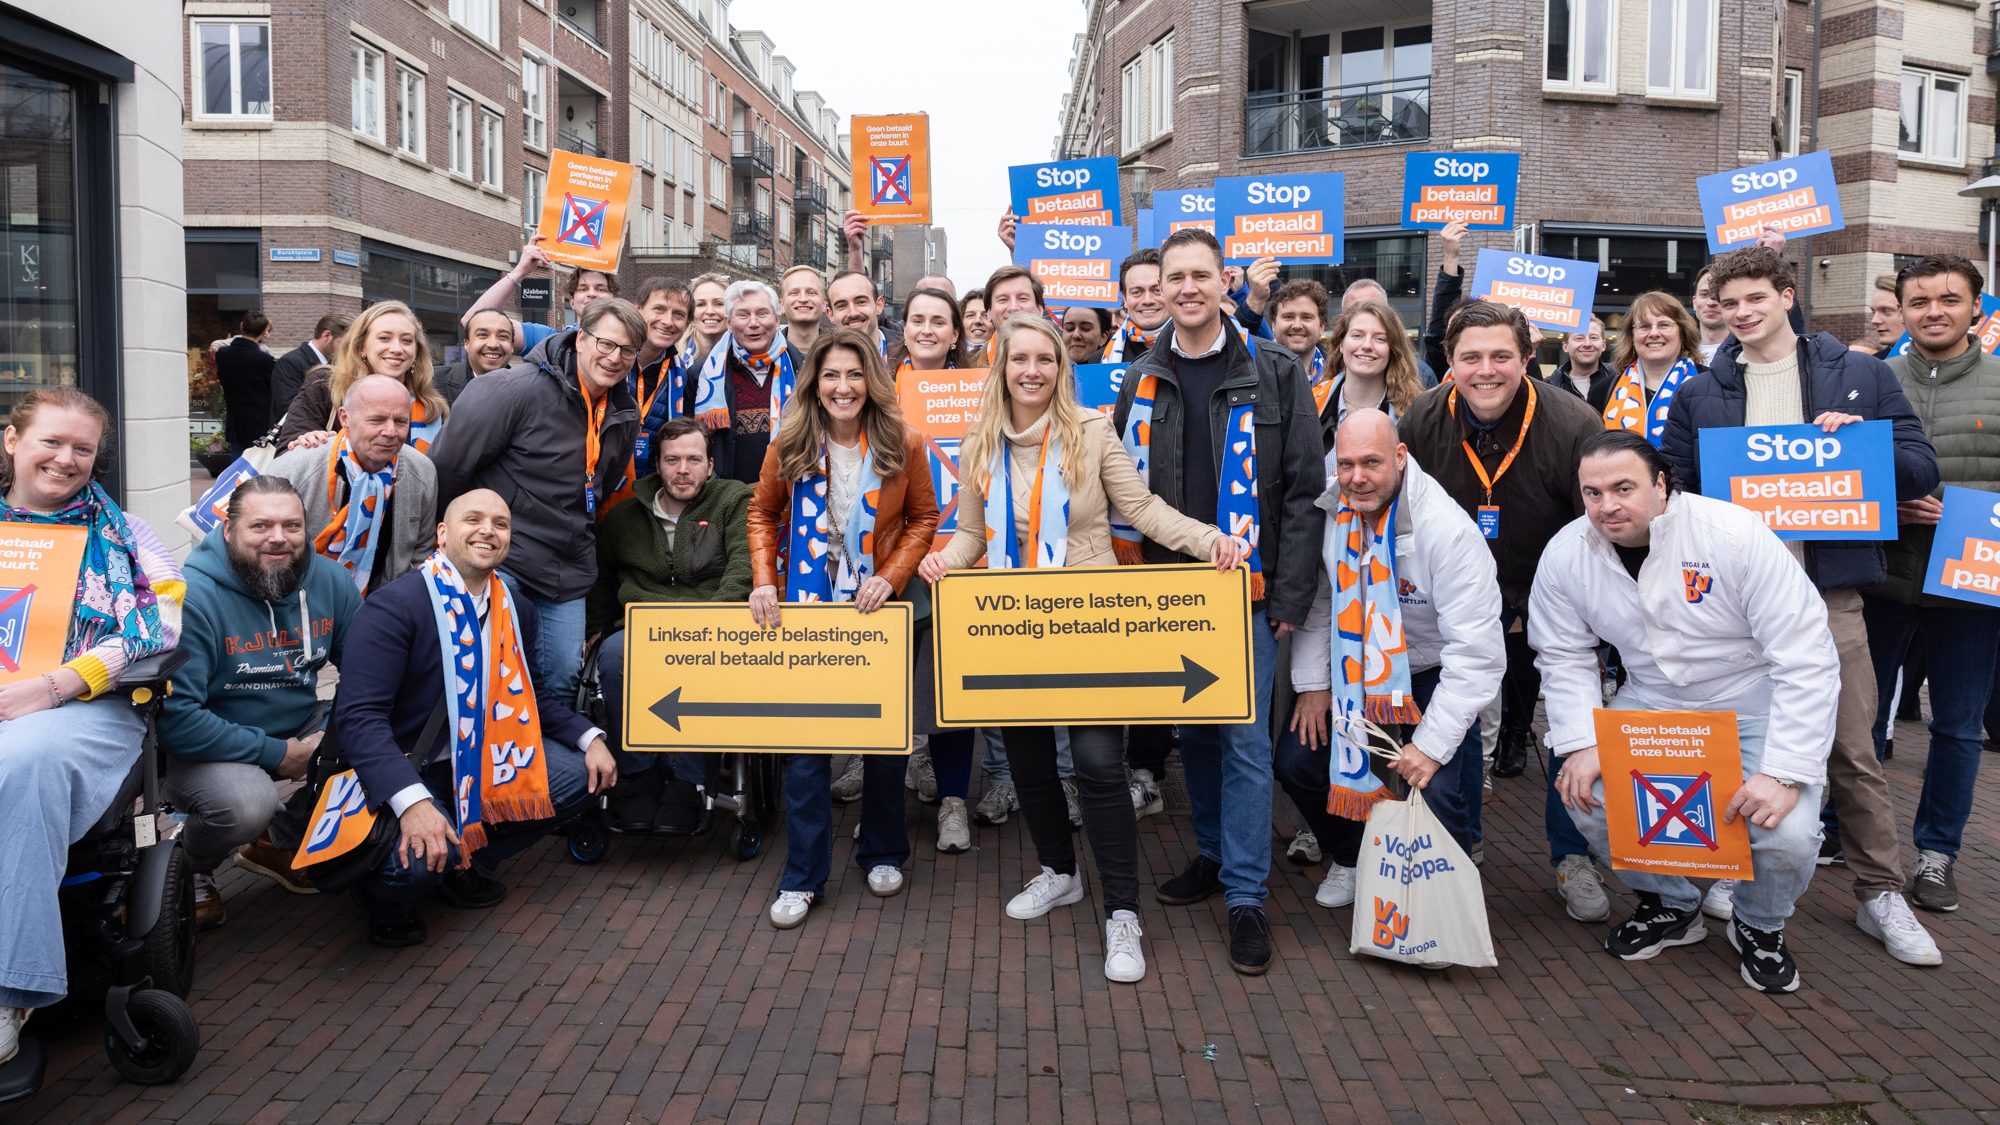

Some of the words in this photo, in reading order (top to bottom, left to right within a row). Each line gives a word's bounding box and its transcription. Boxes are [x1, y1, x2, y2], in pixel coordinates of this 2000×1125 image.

[870, 132, 901, 141] parkeren
[902, 131, 909, 139] in
[888, 139, 910, 147] buurt.
[567, 161, 588, 171] Geen
[589, 166, 618, 178] betaald
[570, 171, 604, 182] parkeren
[605, 176, 612, 184] in
[1036, 167, 1091, 190] Stop
[1433, 157, 1490, 182] Stop
[569, 178, 588, 187] onze
[588, 181, 611, 191] buurt.
[1731, 167, 1798, 194] Stop
[1034, 193, 1098, 213] betaald
[1180, 194, 1215, 213] Sto
[1247, 182, 1311, 209] Stop
[1426, 187, 1492, 203] betaald
[1416, 205, 1499, 223] parkeren!
[1731, 191, 1809, 221] betaald
[1241, 214, 1316, 233] betaald
[1043, 229, 1102, 257] Stop
[1231, 236, 1326, 260] parkeren!
[1037, 261, 1105, 277] betaald
[1506, 257, 1567, 284] Stop
[1043, 281, 1112, 298] arkeren!
[1496, 283, 1568, 305] betaald
[918, 381, 957, 393] Geen
[926, 413, 961, 424] onze
[1747, 433, 1842, 468] Stop
[1741, 475, 1851, 499] betaald
[1758, 503, 1869, 527] arkeren!
[27, 549, 43, 560] in
[1682, 569, 1714, 604] VVD
[974, 595, 1021, 611] VVD:
[1025, 594, 1085, 614] lagere
[1089, 592, 1152, 610] lasten,
[1156, 591, 1206, 609] geen
[1398, 597, 1428, 605] ARTIJN
[648, 627, 713, 643] Linksaf:
[717, 627, 778, 646] hogere
[781, 626, 889, 646] belastingen,
[967, 619, 1044, 640] onnodig
[1049, 617, 1120, 635] betaald
[1125, 616, 1216, 638] parkeren.
[236, 662, 285, 674] Premium
[664, 651, 716, 667] overal
[720, 650, 784, 667] betaald
[788, 650, 872, 670] parkeren.
[1620, 724, 1657, 735] Geen
[1659, 724, 1711, 736] betaald
[1629, 736, 1689, 748] parkeren
[1692, 736, 1705, 747] in
[1630, 749, 1663, 757] onze
[1665, 747, 1706, 758] buurt.
[490, 740, 535, 787] VVD
[1379, 857, 1397, 880] in
[1623, 856, 1739, 871] www.geenbetaaldparkeren.nl
[1372, 895, 1410, 950] VVD
[1398, 939, 1438, 956] Europa
